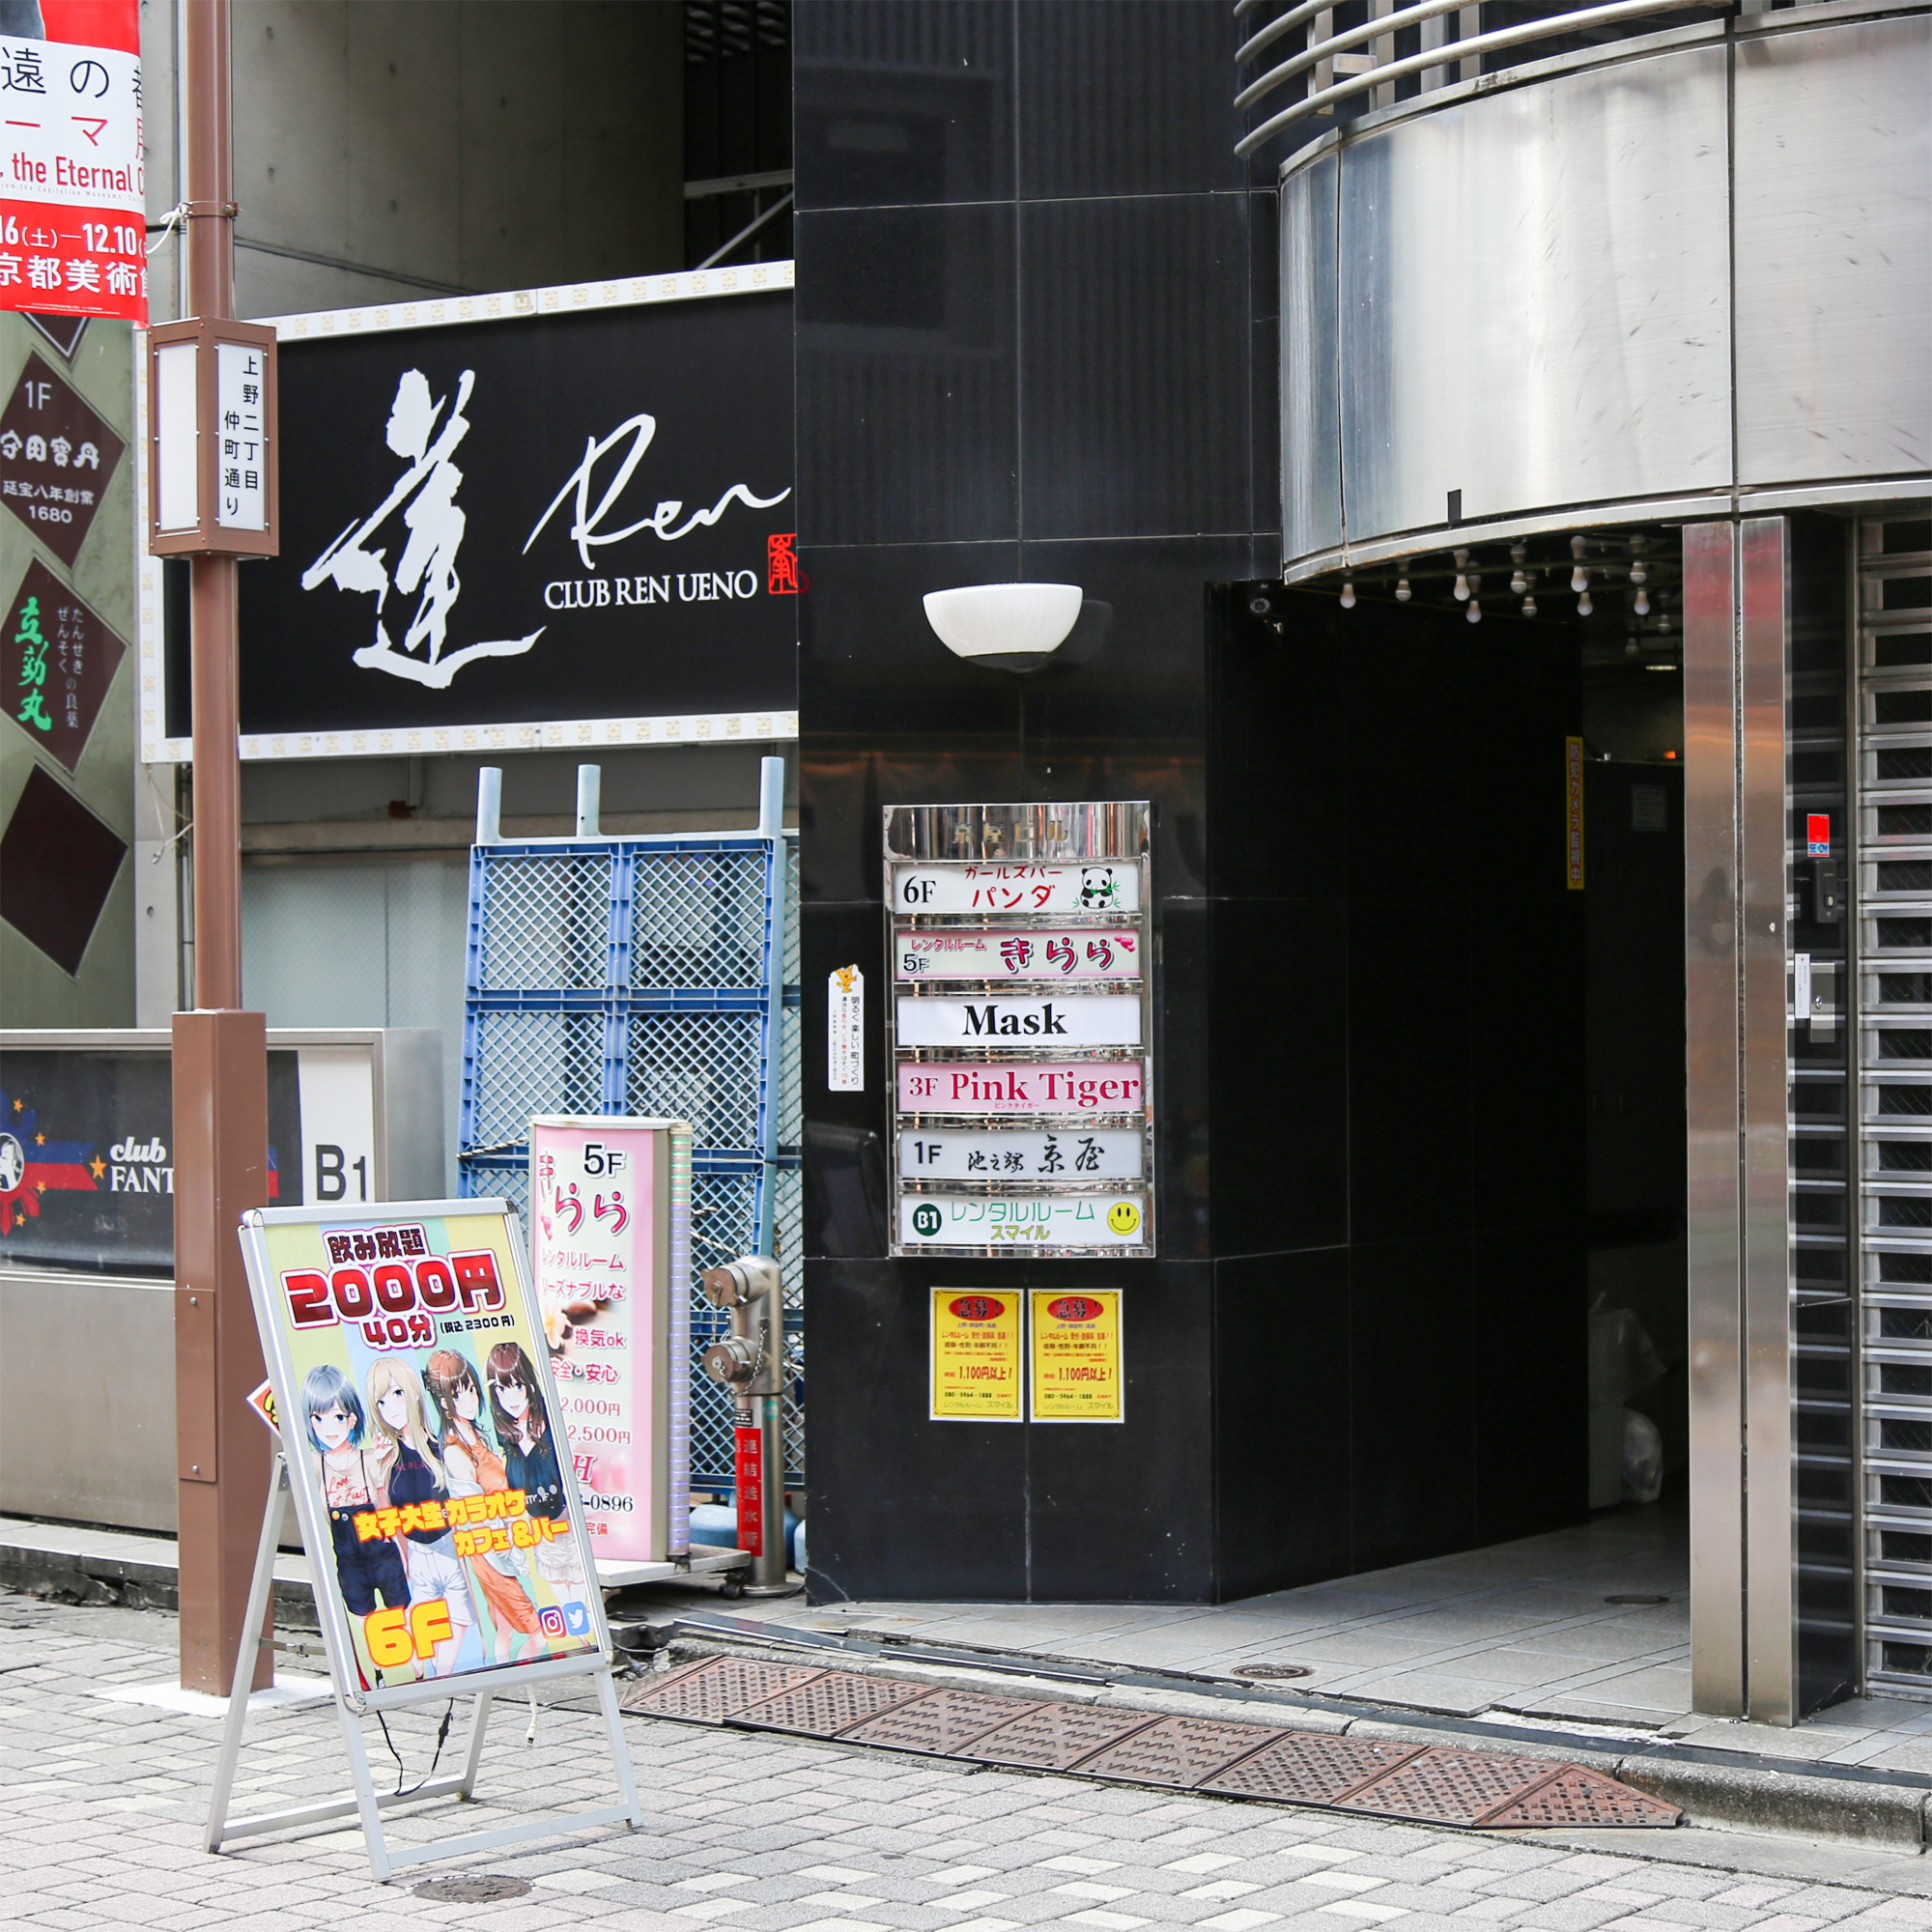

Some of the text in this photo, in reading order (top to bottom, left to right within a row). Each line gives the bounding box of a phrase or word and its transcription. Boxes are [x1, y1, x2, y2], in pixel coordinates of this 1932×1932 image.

[12, 152, 46, 184] the
[55, 156, 133, 192] Eternal
[25, 380, 51, 410] 1F
[242, 355, 260, 490] 上野二丁目
[224, 412, 241, 516] 仲町通り
[3, 480, 95, 506] 延宝八年創業
[29, 505, 72, 524] 1680
[545, 569, 758, 610] CLUB REN UENO
[57, 606, 70, 673] ぜんそく
[71, 608, 84, 674] たんせき
[903, 866, 1064, 904] 6F ガールズバー
[972, 884, 1056, 909] パンダ
[902, 952, 929, 974] 5F
[911, 937, 1115, 975] レンタルルーム きらら
[962, 1003, 1068, 1037] Mask
[909, 1070, 1140, 1108] 3F Pink Tiger
[994, 1101, 1040, 1110] ピンクタイガー
[109, 1136, 167, 1163] club
[583, 1144, 623, 1175] 5F
[914, 1141, 942, 1164] 1F
[1037, 1134, 1105, 1174] 京屋
[315, 1144, 366, 1201] B1
[539, 1151, 629, 1234] きらら
[917, 1200, 1094, 1230] B1 レンタルルーム
[327, 1228, 426, 1264] 飲み放題
[990, 1225, 1050, 1241] スマイル
[542, 1251, 624, 1269] レンタルルーム
[283, 1251, 502, 1326] 2000円
[542, 1278, 624, 1299] リーズナブルな
[362, 1312, 434, 1347] 40分
[575, 1327, 624, 1348] 換気ok
[551, 1358, 618, 1382] 安全・安心
[560, 1396, 620, 1417] 2,000円
[986, 1401, 1013, 1409] スマイル
[1087, 1402, 1115, 1410] スマイル
[567, 1424, 631, 1445] 2,500円
[744, 1439, 758, 1547] 連結送水管
[364, 1600, 453, 1668] 6F
